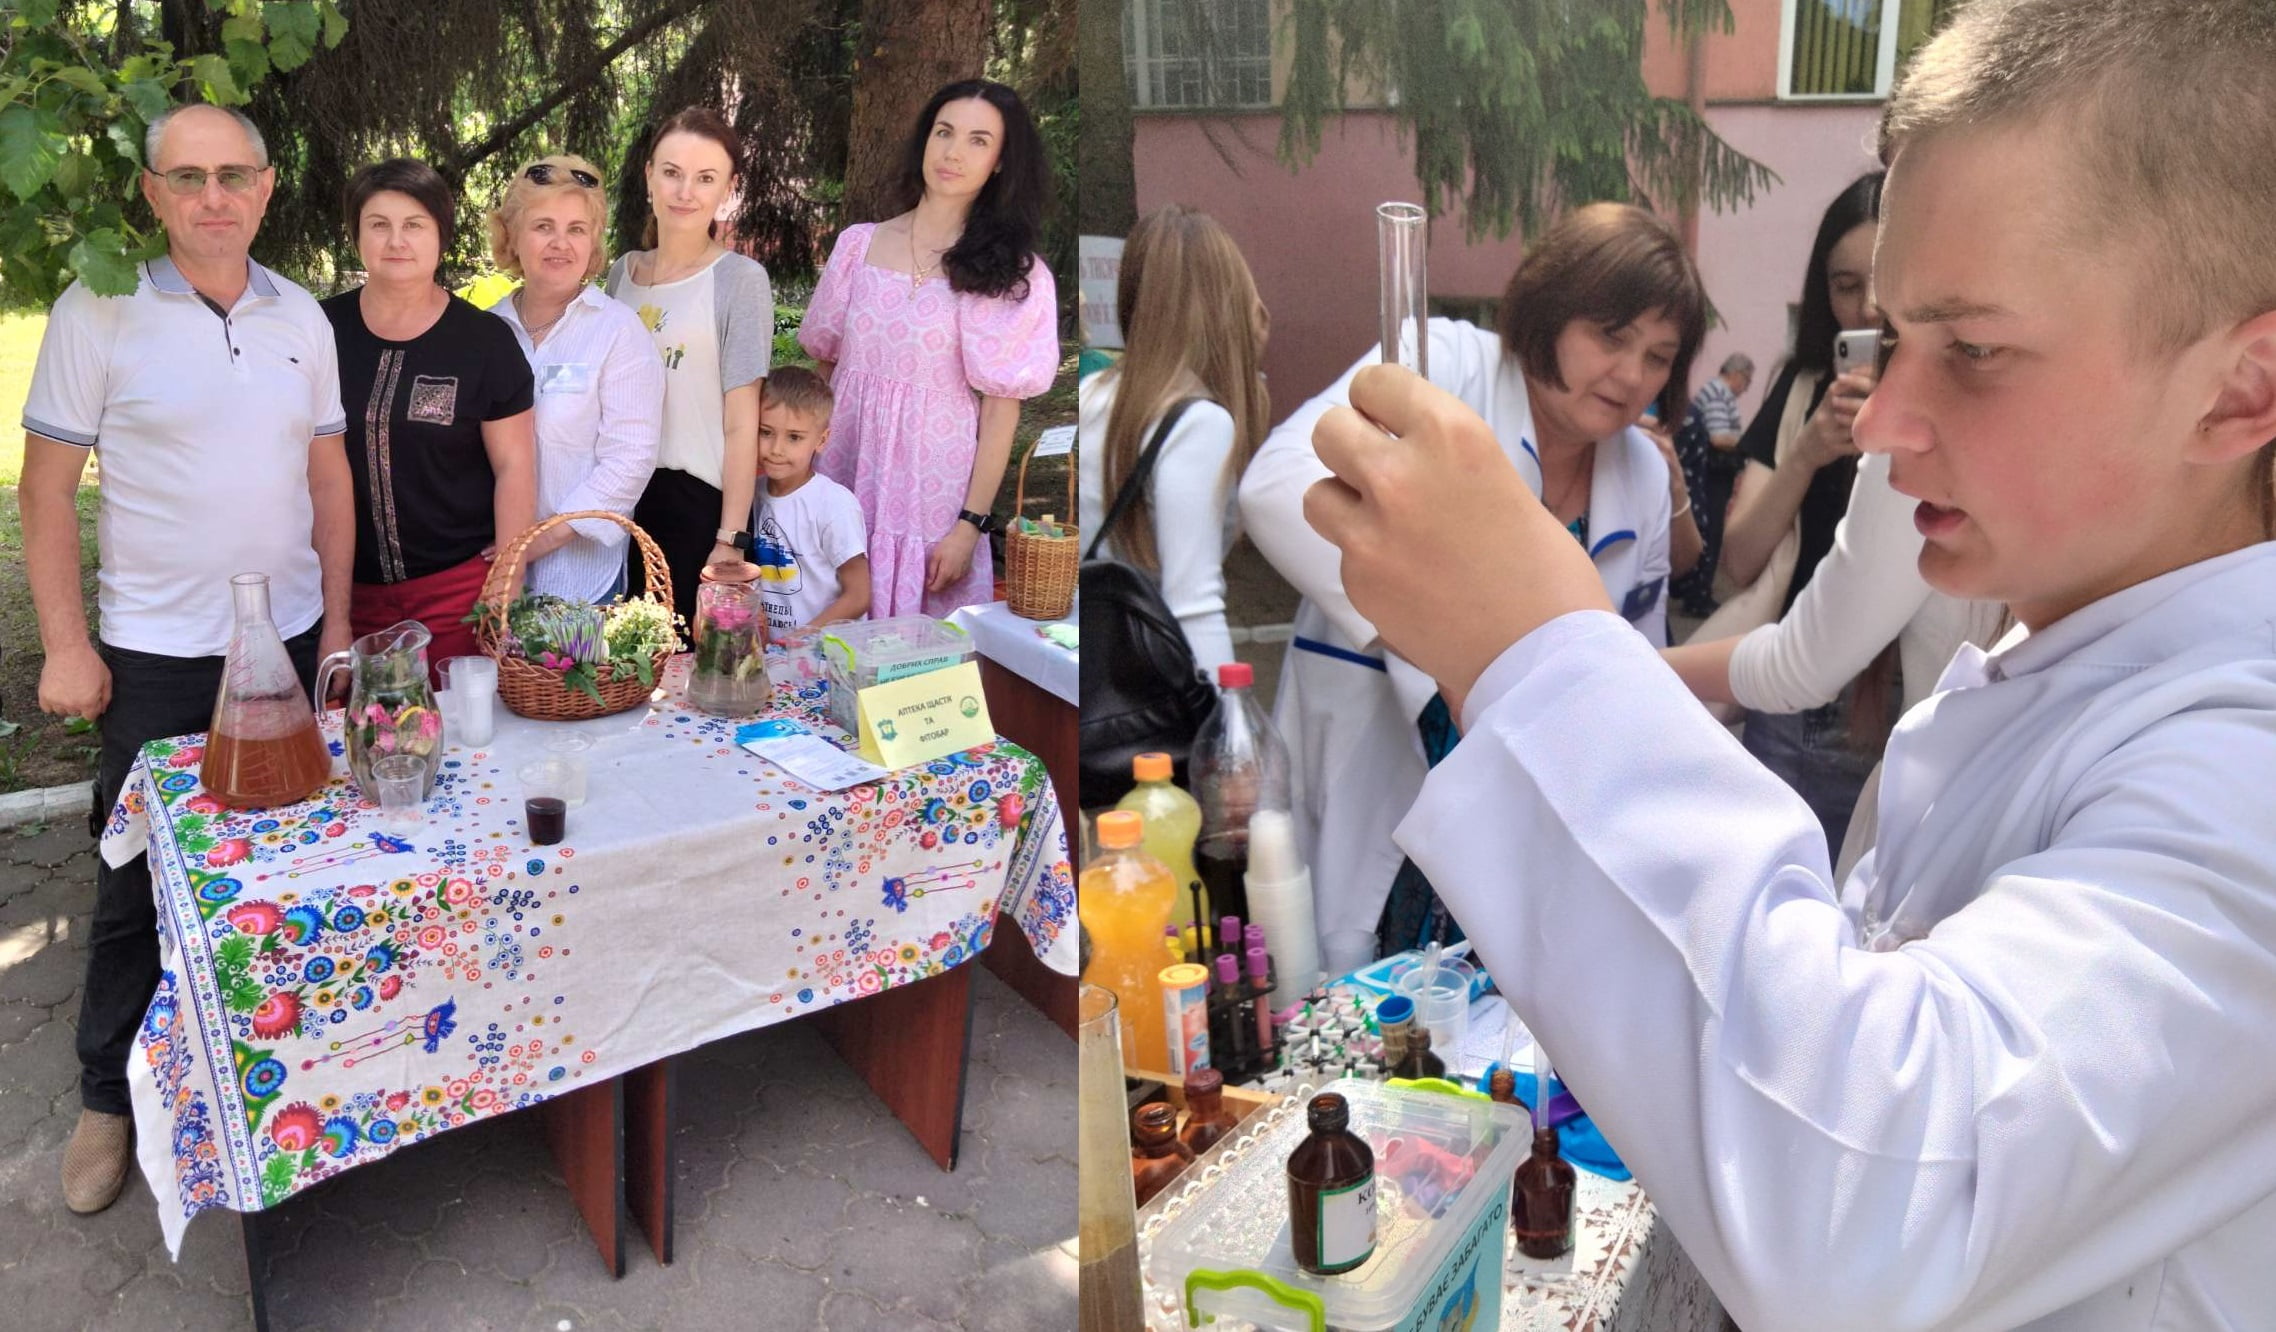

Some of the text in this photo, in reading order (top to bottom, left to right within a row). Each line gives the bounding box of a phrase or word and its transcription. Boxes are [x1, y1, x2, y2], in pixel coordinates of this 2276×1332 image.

[889, 655, 949, 673] ДОБРИХ СПРАВ
[898, 695, 953, 717] АПТЕКА ЩАСТЯ
[924, 716, 935, 726] ТА
[919, 728, 950, 742] ФІТОБАР
[1451, 1203, 1503, 1281] ЗАБАГАТО
